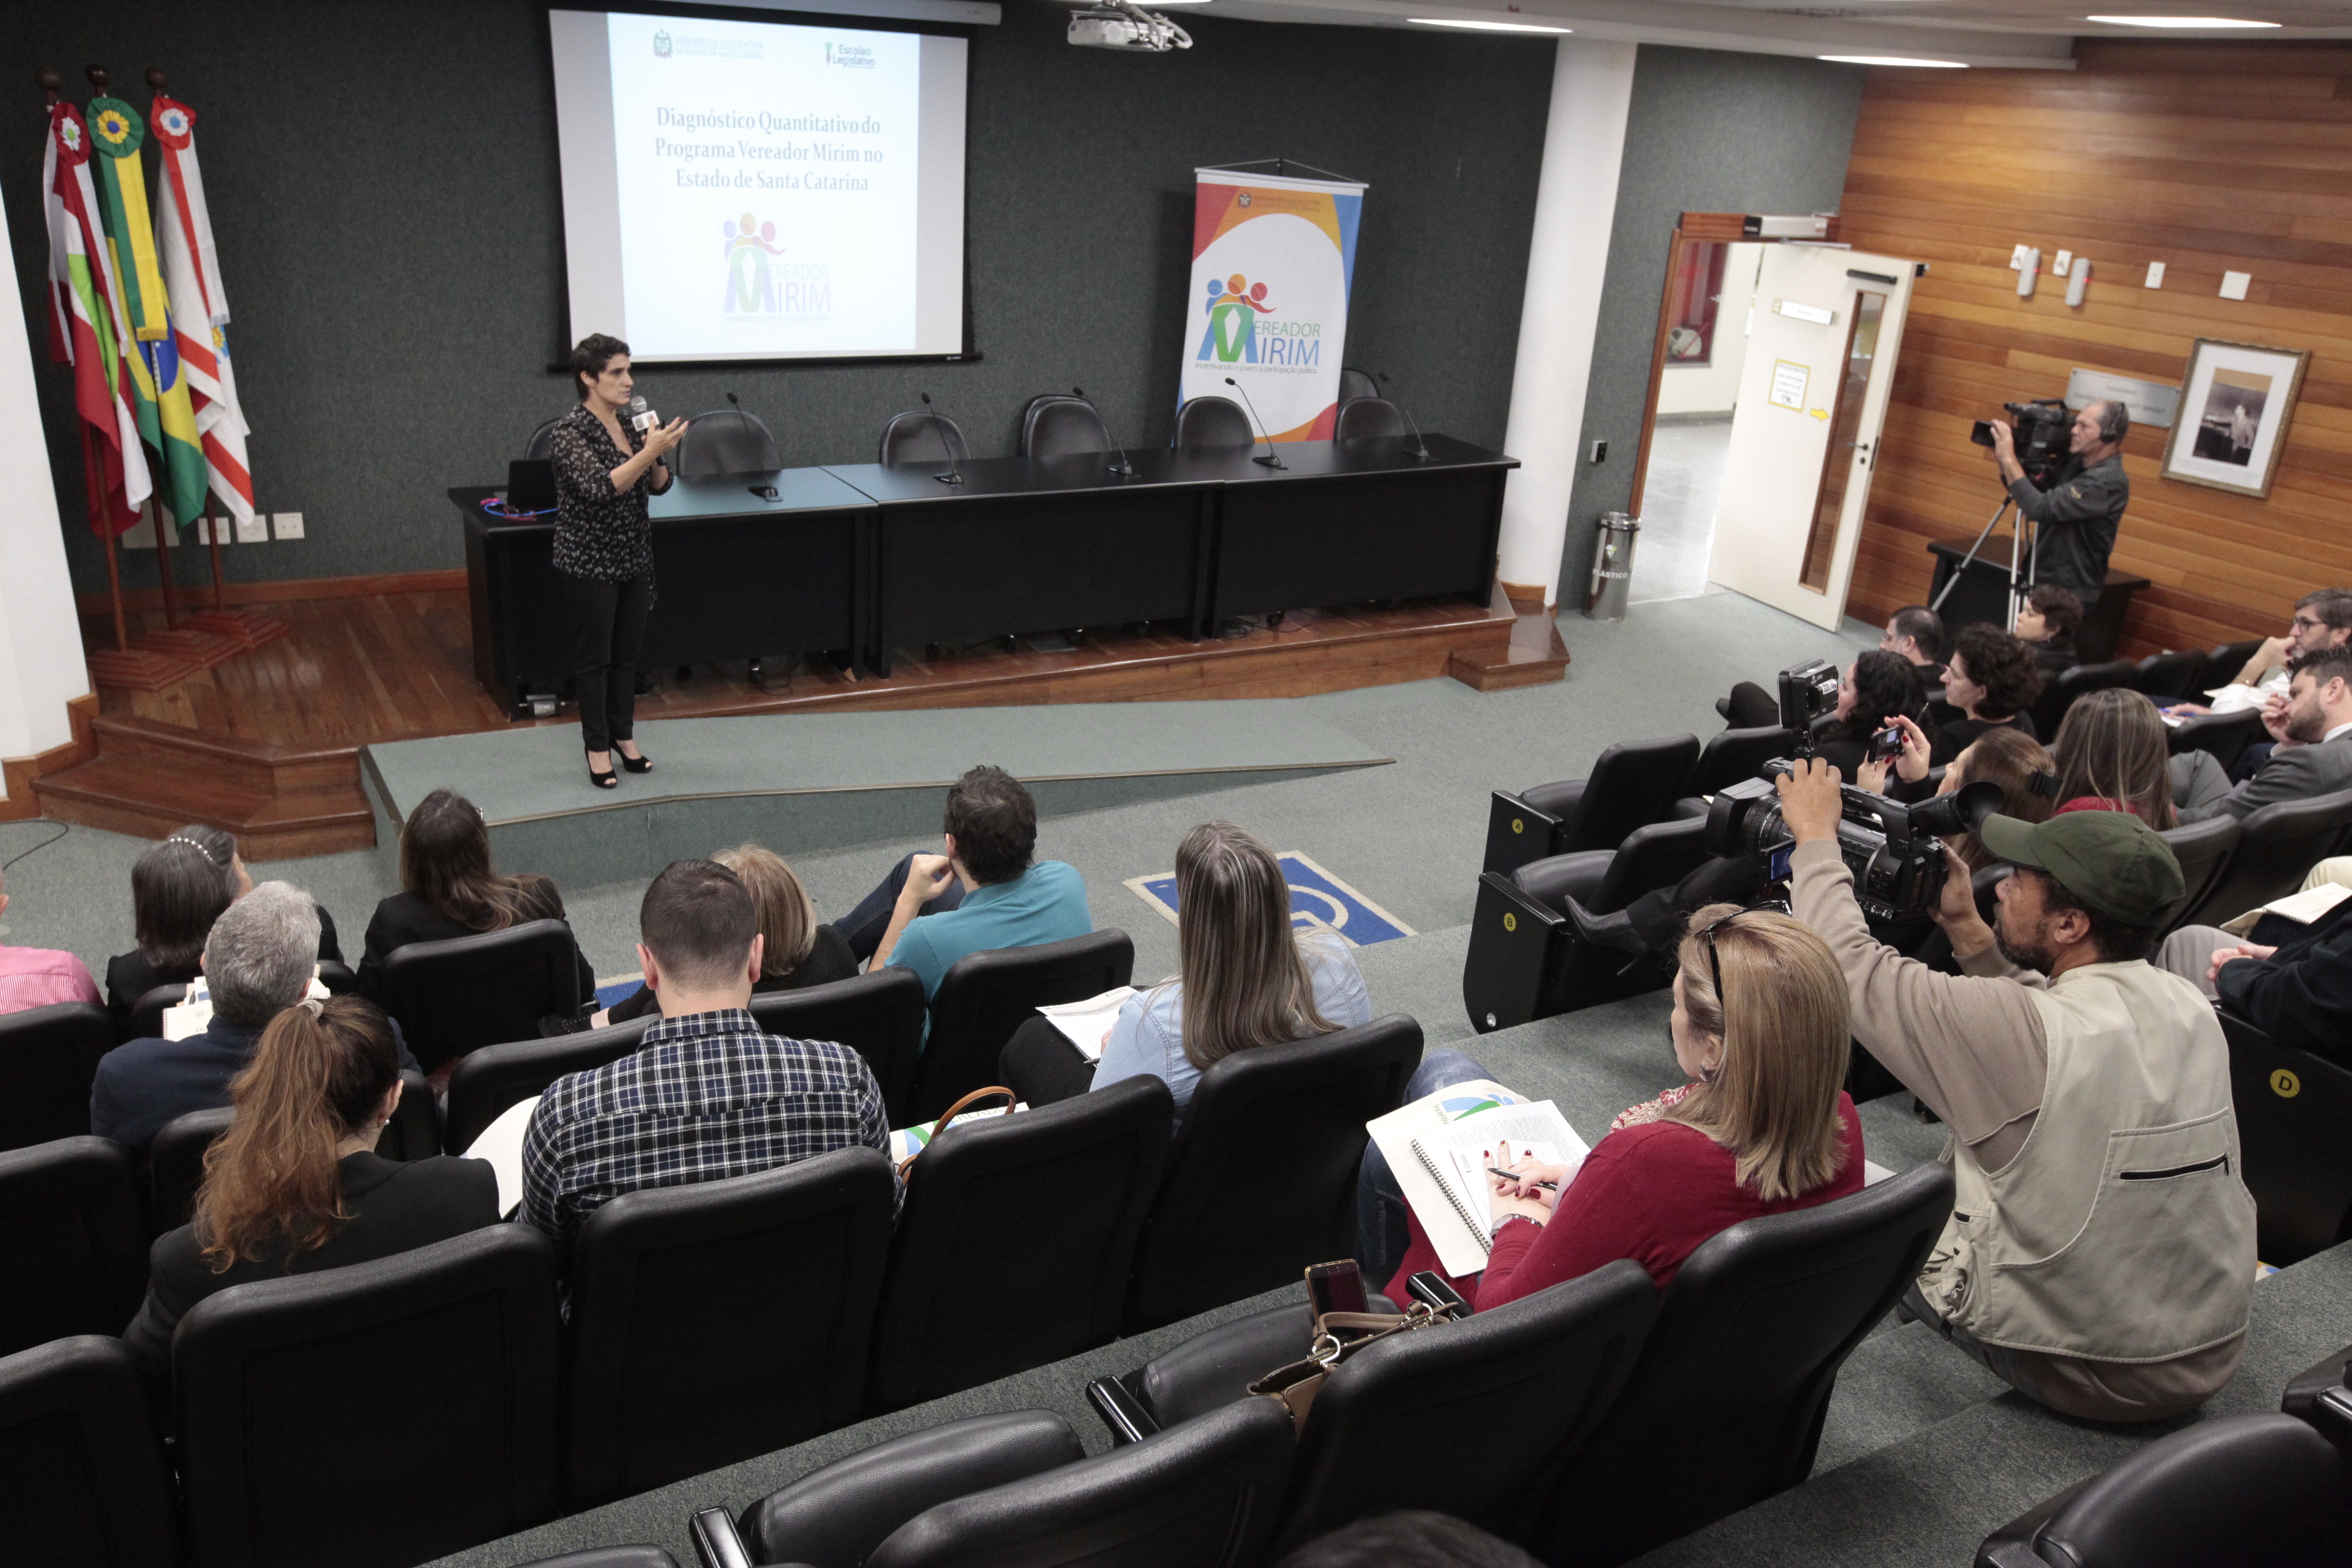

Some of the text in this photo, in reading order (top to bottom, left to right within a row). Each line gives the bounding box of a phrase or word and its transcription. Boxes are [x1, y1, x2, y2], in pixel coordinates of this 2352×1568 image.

[838, 44, 865, 55] Escola
[832, 54, 876, 67] Legislativo
[656, 106, 881, 135] Diagnóstico Quantitativo do
[655, 138, 883, 163] Programa Vereador Mirim no
[676, 168, 869, 191] Estado de Santa Catarina
[1194, 362, 1233, 371] Incentivando
[1239, 364, 1258, 372] jovem
[1263, 365, 1297, 375] participação
[1298, 366, 1317, 375] política
[1515, 823, 1521, 831] A
[1506, 917, 1513, 928] B
[2278, 1076, 2293, 1091] D
